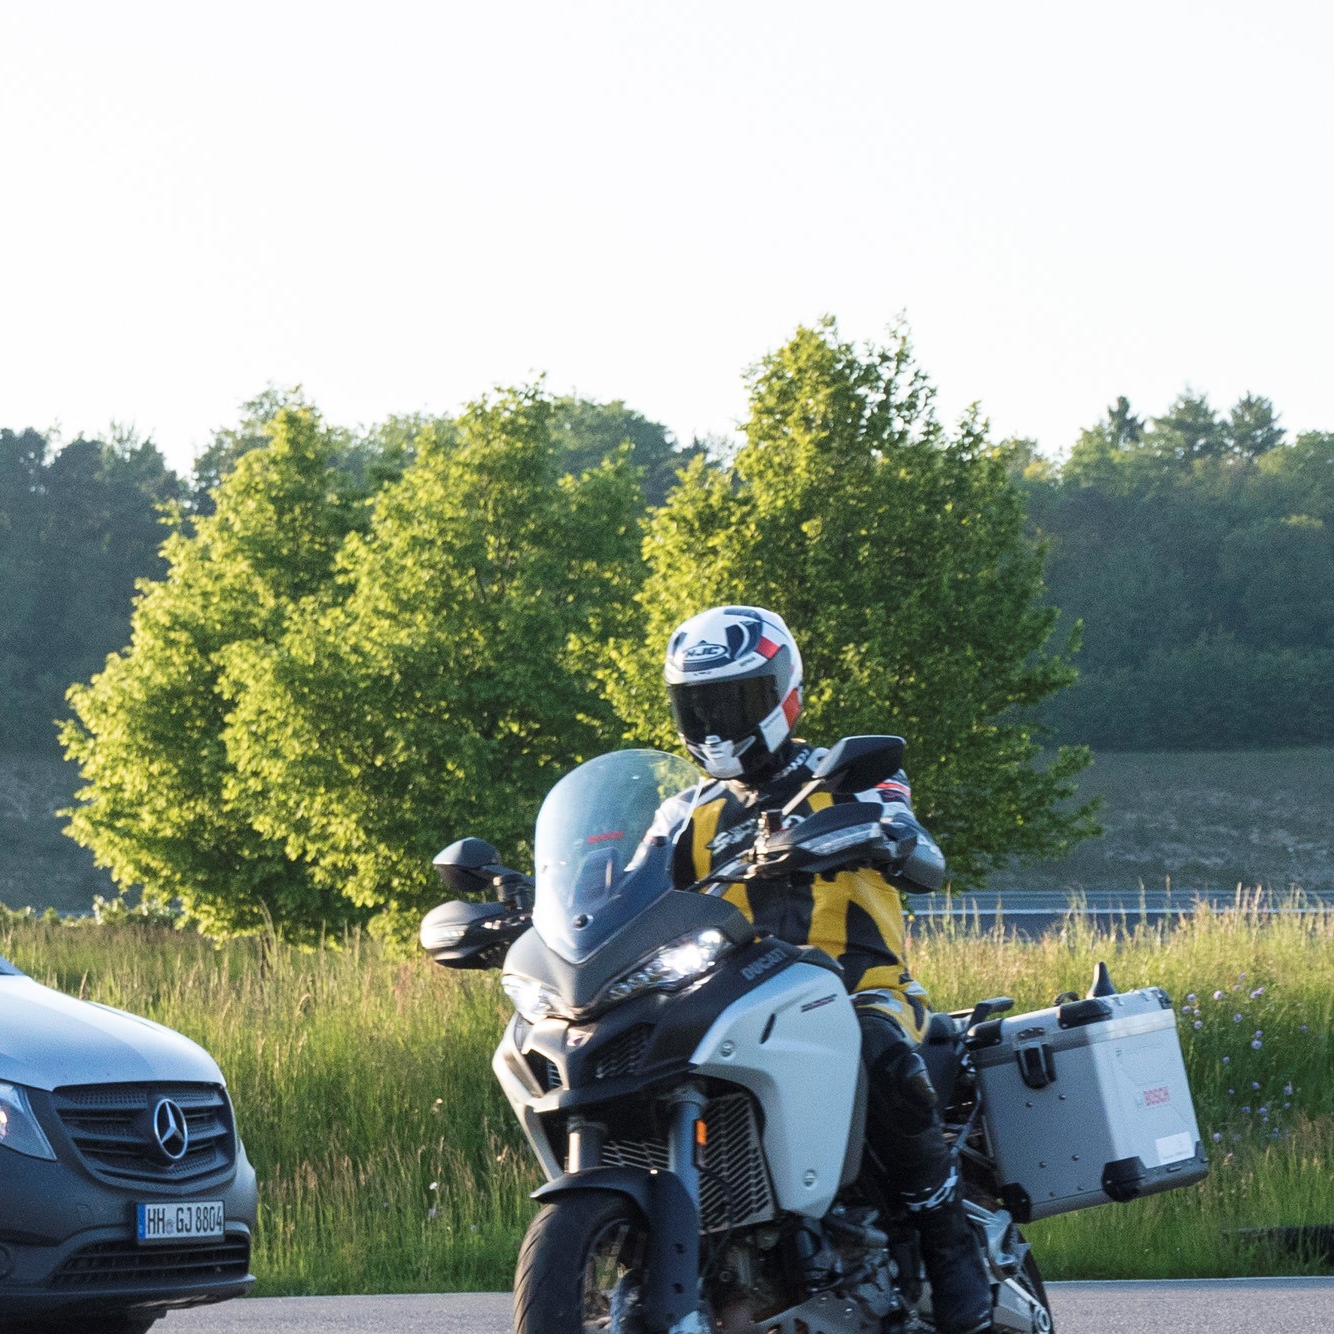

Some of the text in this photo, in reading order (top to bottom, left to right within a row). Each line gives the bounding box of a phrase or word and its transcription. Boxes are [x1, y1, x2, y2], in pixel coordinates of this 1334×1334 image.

[687, 645, 720, 657] HJC
[740, 947, 787, 980] DUCATI
[147, 1207, 165, 1234] HH
[176, 1207, 192, 1233] GJ
[196, 1206, 222, 1232] 8804
